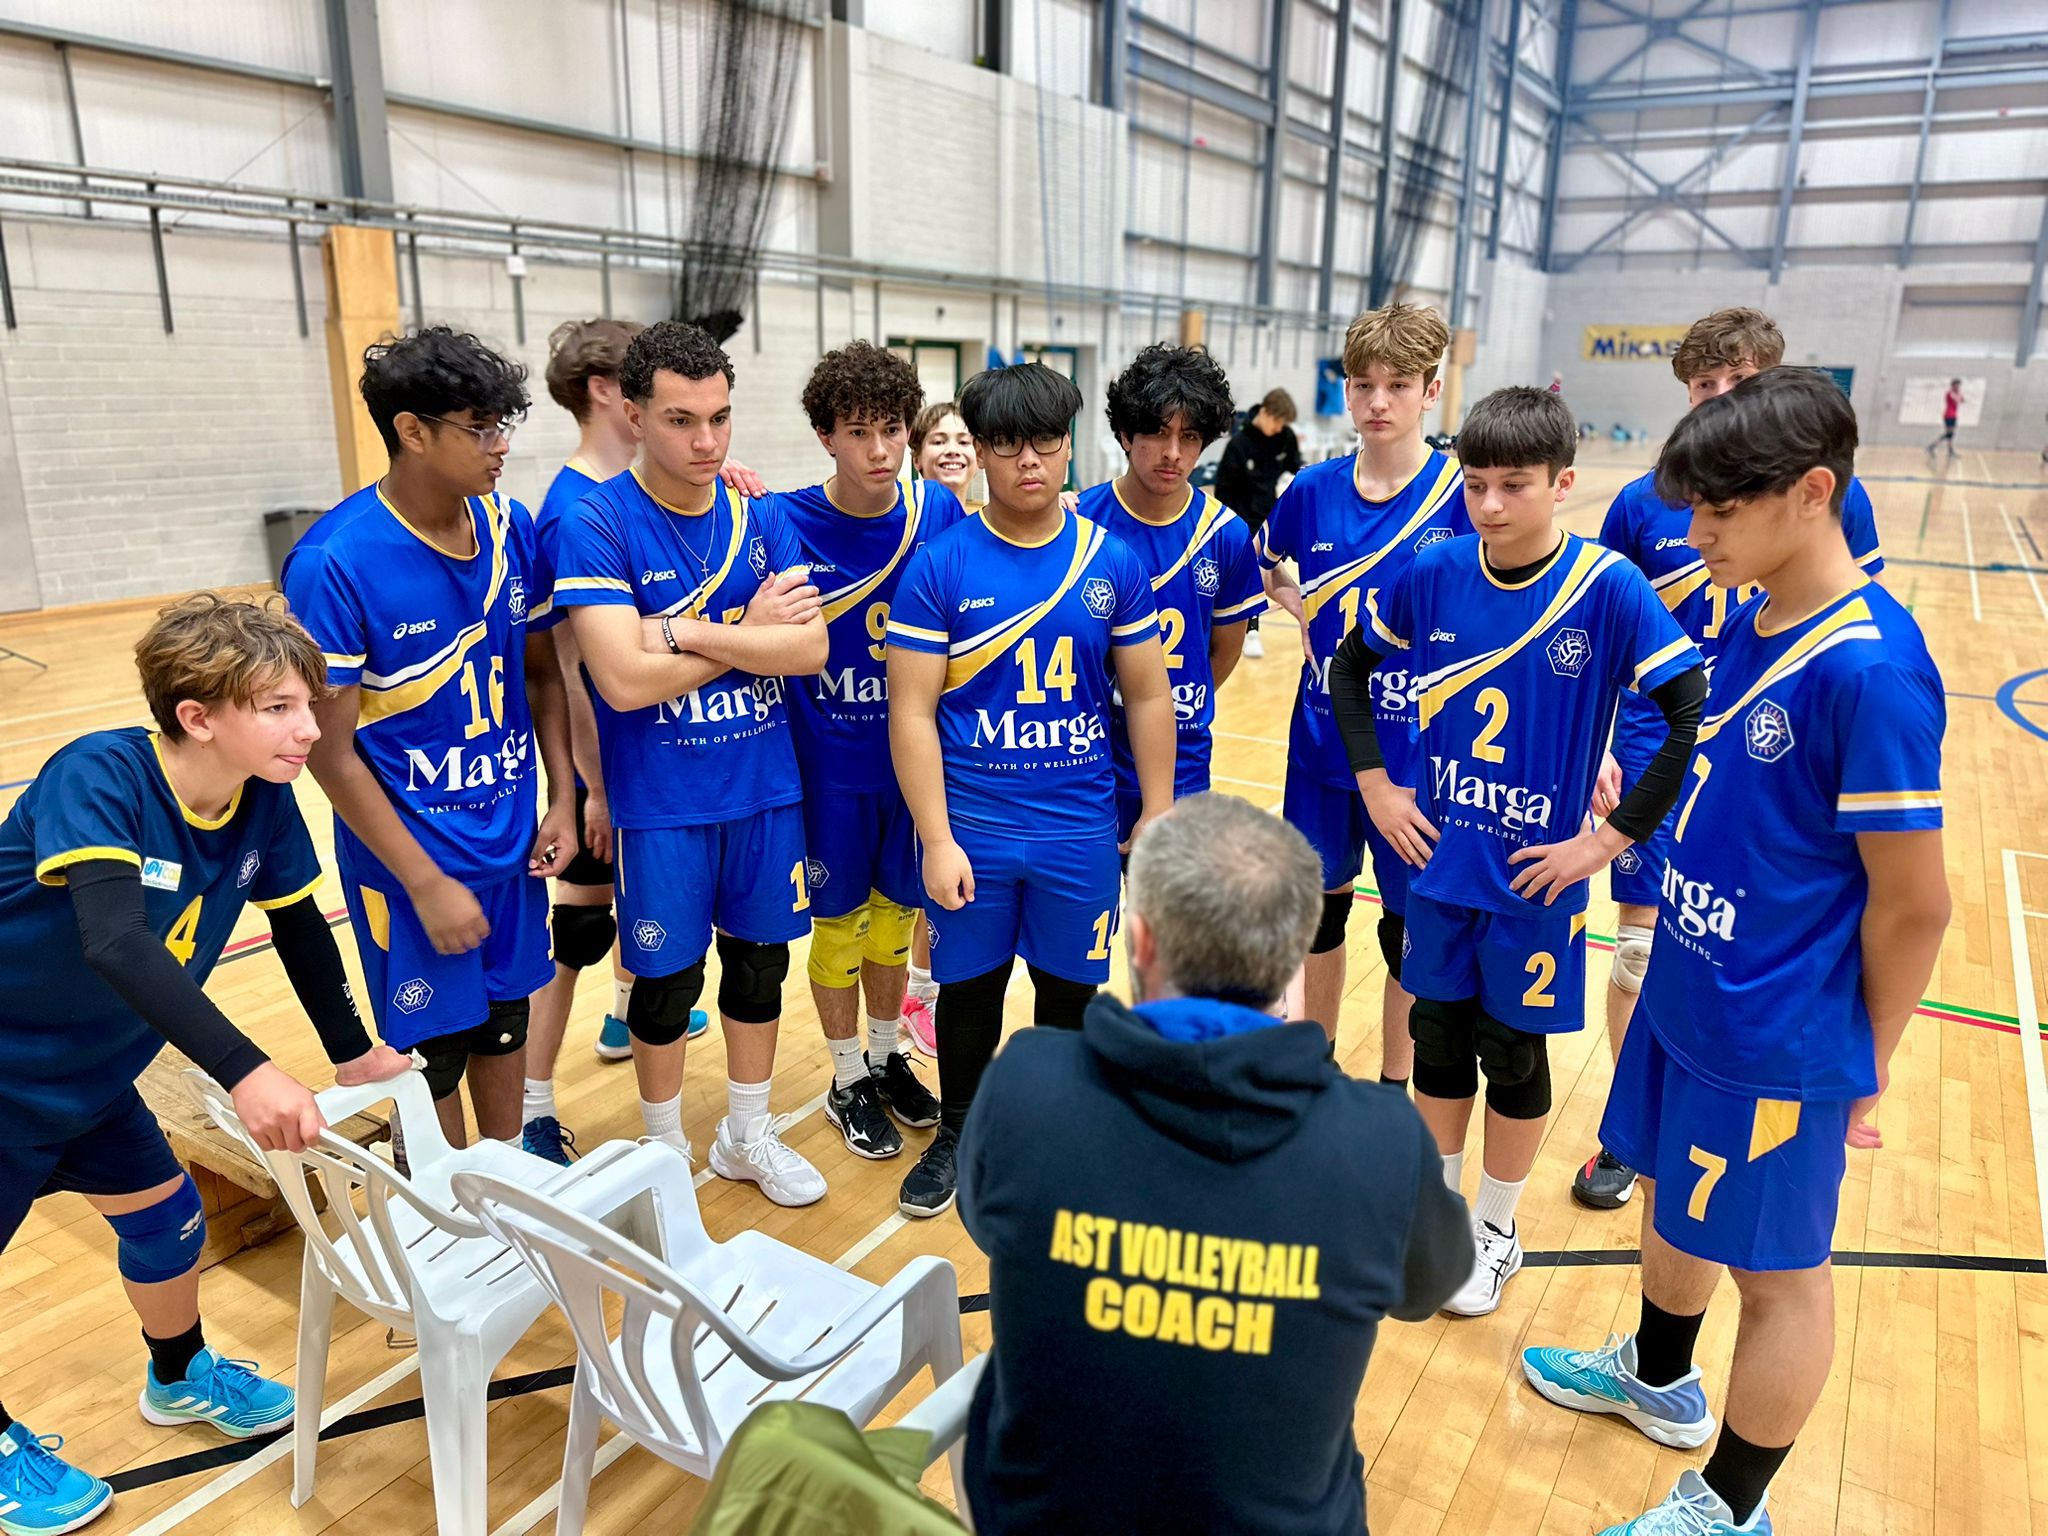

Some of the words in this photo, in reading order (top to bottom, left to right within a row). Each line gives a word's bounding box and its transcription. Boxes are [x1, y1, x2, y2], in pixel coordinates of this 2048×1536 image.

[1591, 331, 1682, 357] MiKAS
[1667, 537, 1688, 548] asic
[653, 569, 677, 582] asics
[813, 564, 837, 573] asics
[969, 597, 995, 609] asics
[408, 619, 437, 635] asics
[865, 601, 891, 661] 9
[816, 667, 889, 703] Mar
[1015, 636, 1077, 704] 14
[655, 677, 783, 724] Marga
[831, 713, 856, 721] PATH
[1372, 713, 1414, 723] LBEING
[677, 737, 707, 746] PATH
[713, 735, 728, 743] OF
[969, 708, 1106, 755] Marga
[1472, 687, 1509, 764] 2
[1044, 753, 1099, 769] WELLBEING
[429, 804, 461, 814] PATH
[469, 802, 485, 810] OF
[1430, 756, 1552, 831] Marga
[1455, 819, 1471, 828] OF
[1661, 857, 1736, 941] arga
[165, 895, 203, 967] 4
[1523, 951, 1556, 1007] 2
[1687, 1144, 1728, 1222] 7
[1050, 1208, 1118, 1271] AST
[1120, 1221, 1321, 1300] VOLLEYBALL
[1084, 1276, 1275, 1356] COACH
